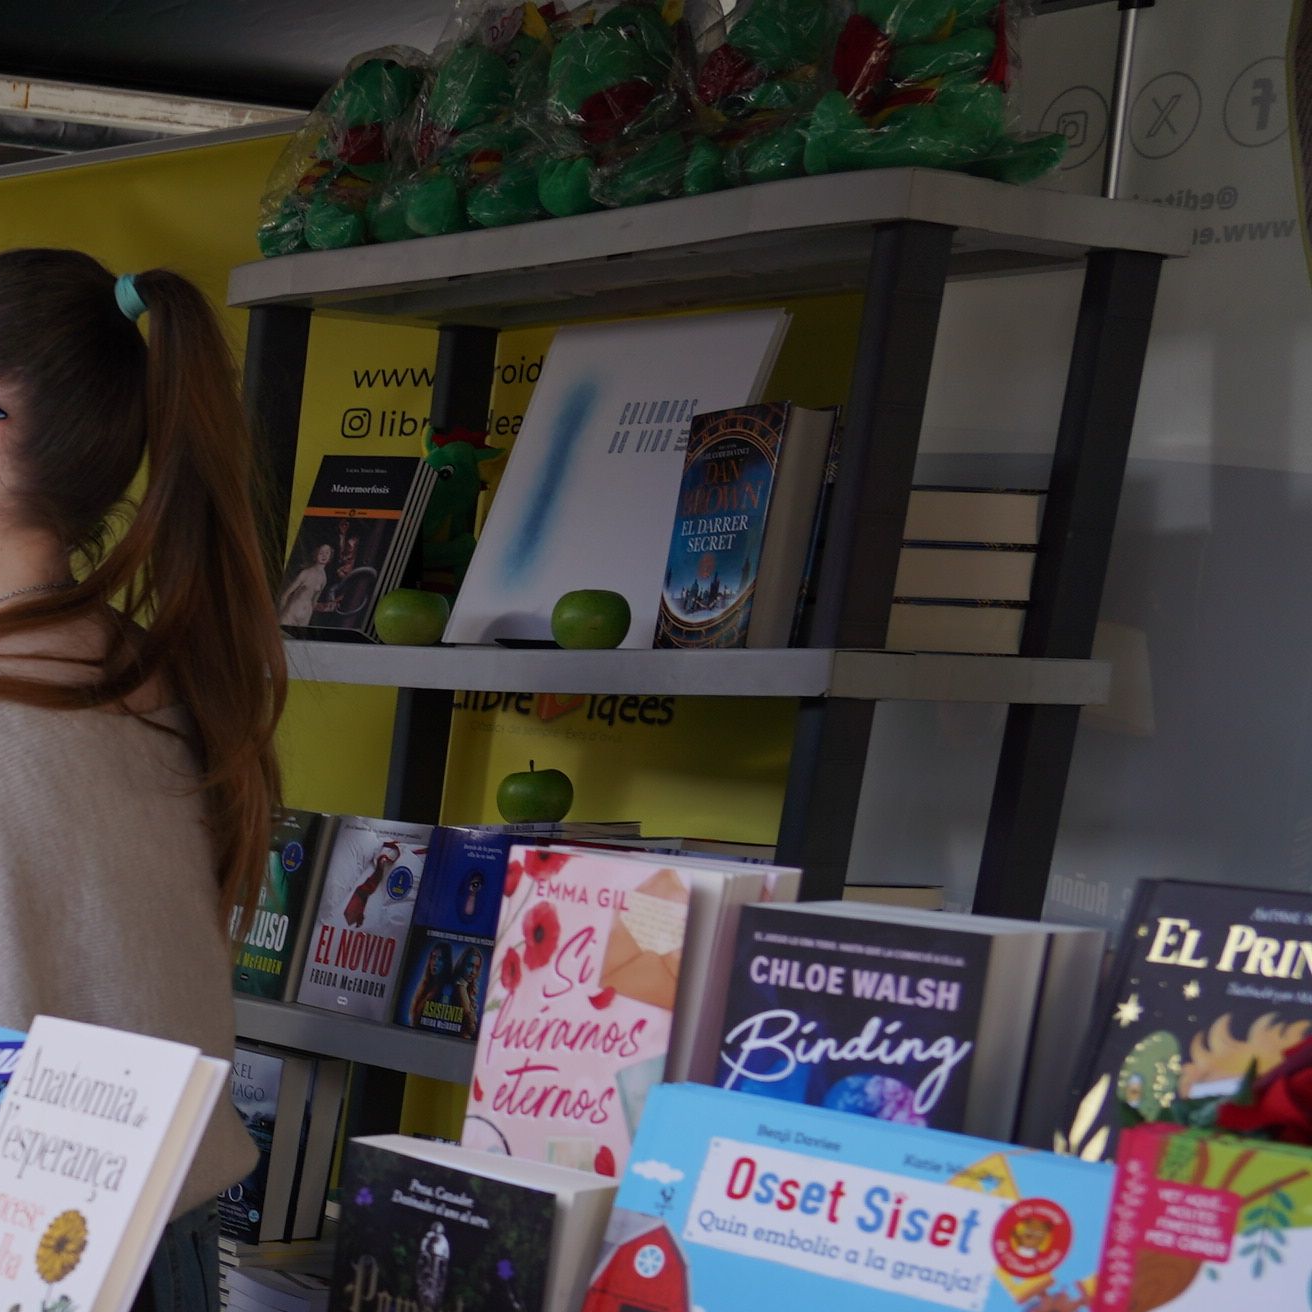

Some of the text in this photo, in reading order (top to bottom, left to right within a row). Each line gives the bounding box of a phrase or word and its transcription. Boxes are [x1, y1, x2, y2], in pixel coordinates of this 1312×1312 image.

[331, 483, 391, 495] Matermorfosis
[681, 515, 749, 537] EL DARRER
[687, 533, 737, 553] SECRET
[536, 879, 631, 912] EMMA GIL
[314, 924, 330, 965] EL
[334, 927, 397, 978] NOVIO
[542, 925, 598, 999] Si
[1144, 915, 1312, 981] EL PRIN
[309, 968, 386, 999] FREIDA McFADDEN
[749, 954, 962, 1012] CHLOE WALSH
[486, 989, 648, 1065] fuéramos
[11, 1046, 139, 1128] Anatomia
[491, 1056, 616, 1125] eternos
[721, 1008, 973, 1115] Binding
[725, 1156, 847, 1225] Osset
[857, 1185, 981, 1256] Siset
[697, 1208, 748, 1238] Quin
[752, 1219, 841, 1262] embolic
[843, 1248, 860, 1266] a
[864, 1246, 886, 1273] la
